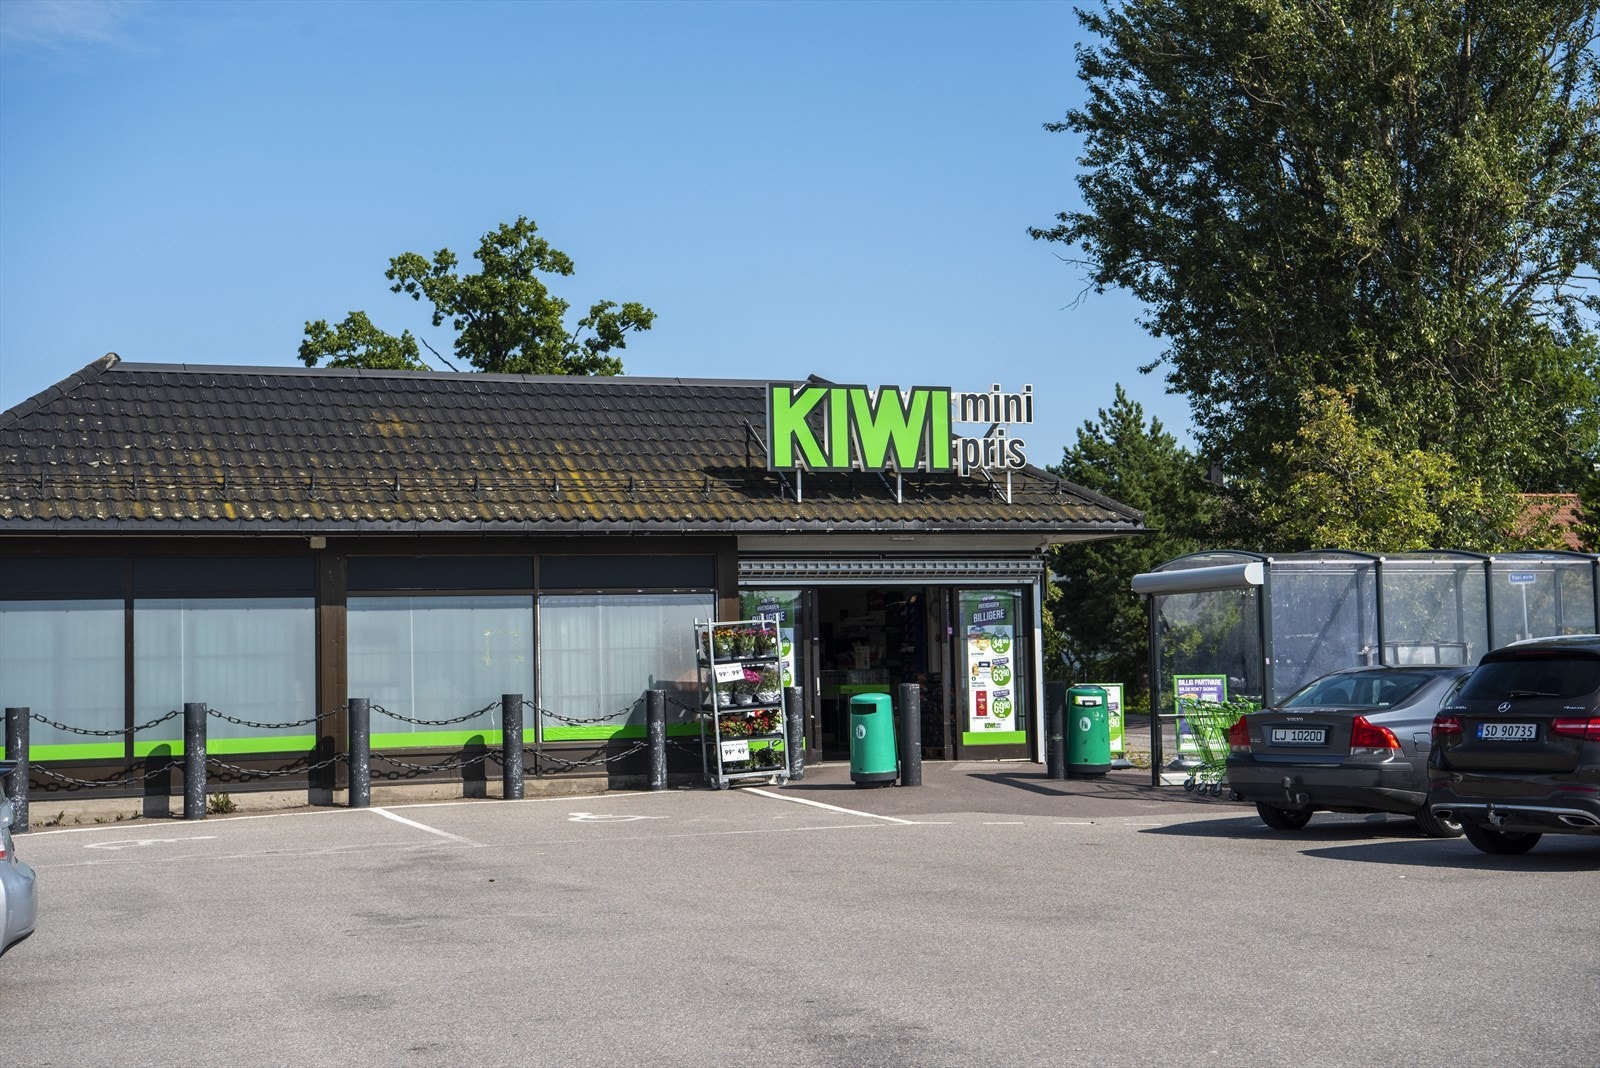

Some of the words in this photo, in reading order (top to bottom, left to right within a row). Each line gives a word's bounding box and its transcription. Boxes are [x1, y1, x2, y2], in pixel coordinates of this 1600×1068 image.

[767, 384, 951, 472] KIWI
[960, 384, 1033, 423] mini
[960, 429, 1027, 476] pris
[973, 609, 1005, 623] BILLIGERE
[1274, 731, 1287, 741] LJ
[1291, 731, 1322, 742] 10200
[1485, 725, 1498, 737] SD
[1501, 725, 1533, 738] 90735
